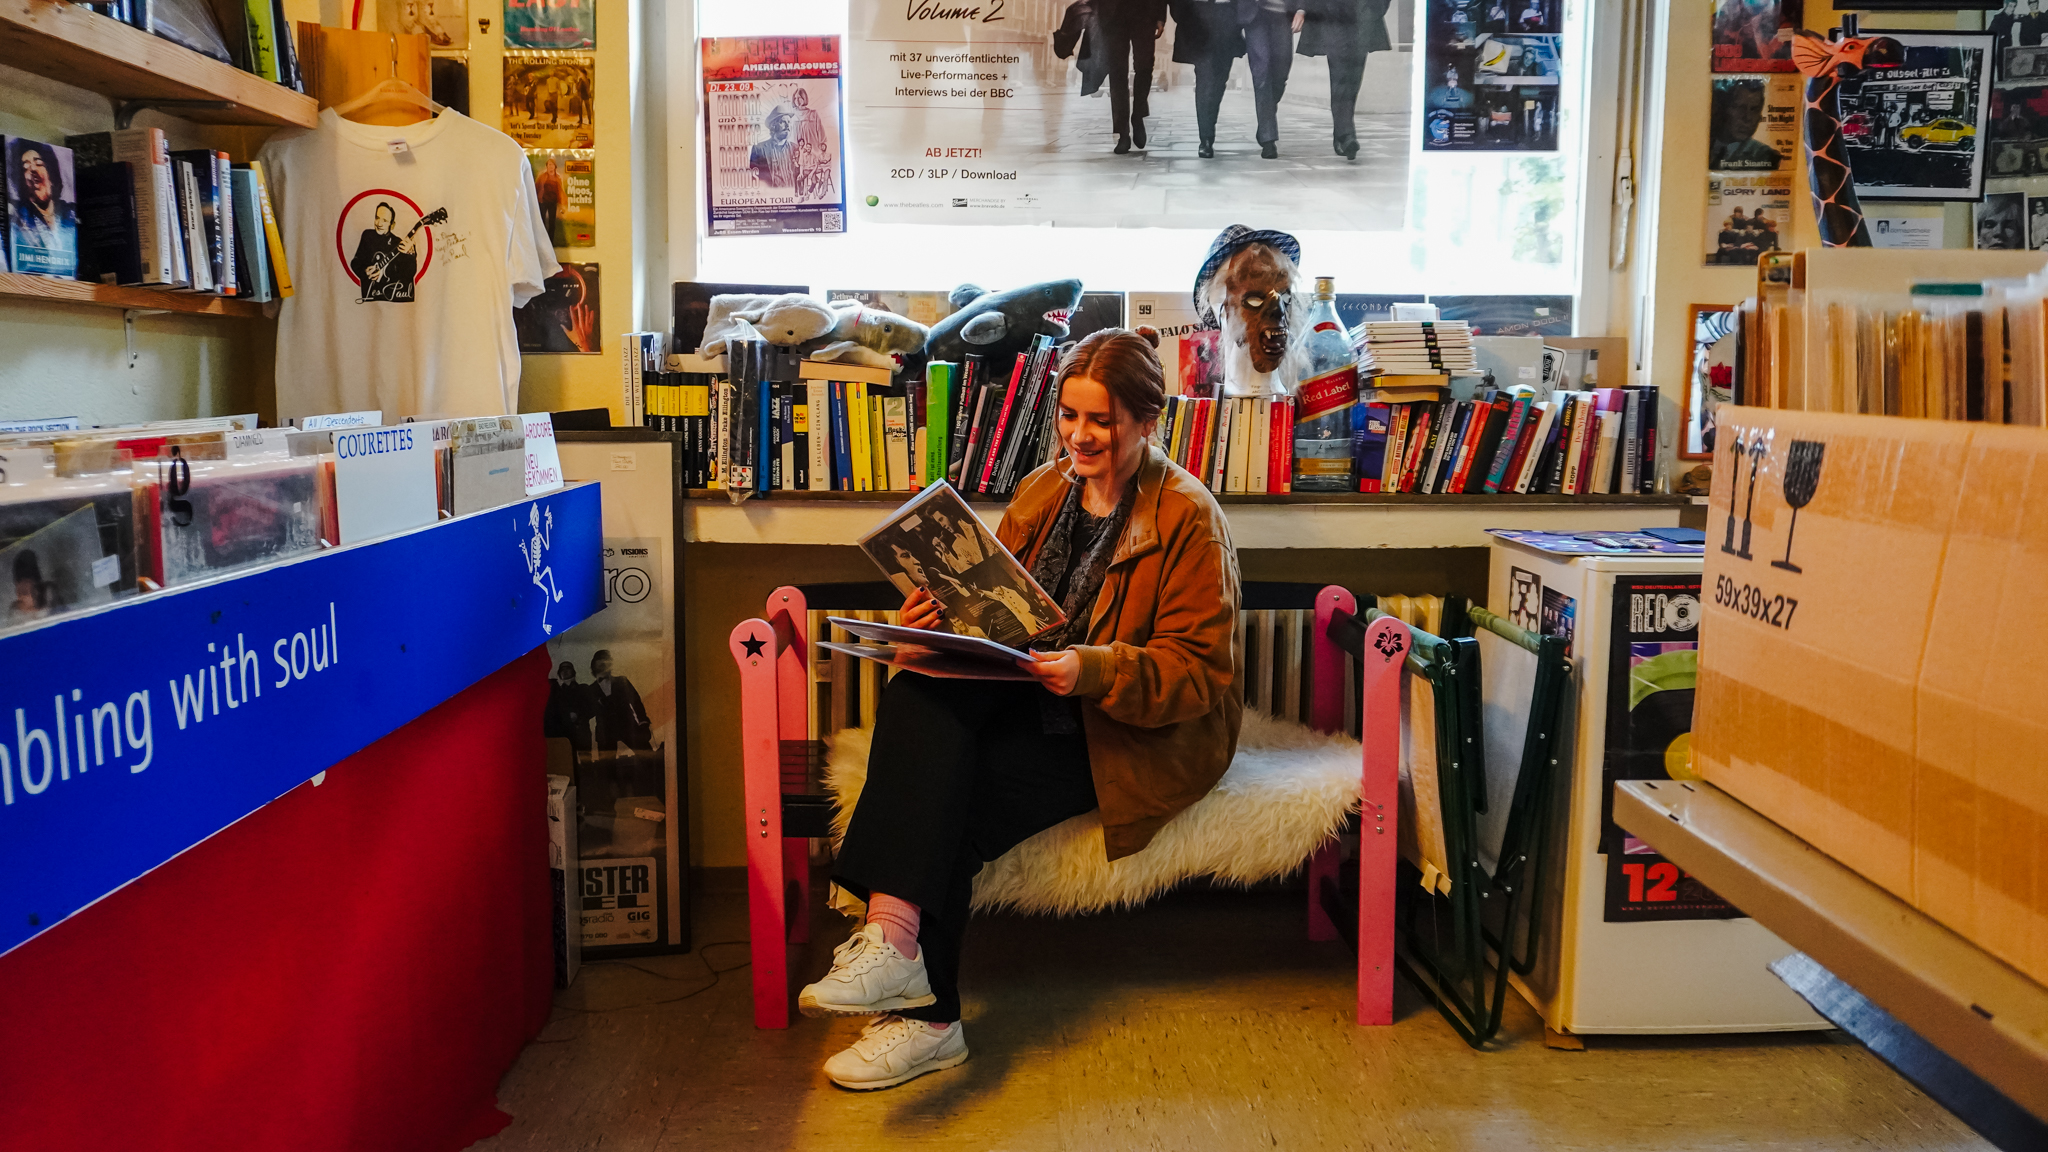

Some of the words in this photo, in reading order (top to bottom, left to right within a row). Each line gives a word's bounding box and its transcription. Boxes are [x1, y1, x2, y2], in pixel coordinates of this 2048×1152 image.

[906, 0, 981, 21] Volume
[982, 0, 1005, 23] 2
[889, 53, 907, 62] mit
[909, 53, 922, 62] 37
[925, 53, 1020, 64] unveröffentlichten
[743, 62, 839, 72] AMERICANASOUNDS
[900, 69, 998, 81] Live-Performances
[1001, 73, 1008, 81] +
[724, 84, 737, 92] 23.
[739, 83, 752, 92] 09.
[895, 86, 948, 97] Interviews
[950, 87, 967, 98] bei
[969, 87, 988, 98] der
[990, 88, 1014, 99] BBC
[1767, 104, 1796, 114] Strangers
[718, 116, 737, 124] and
[1767, 114, 1779, 123] The
[1778, 114, 1795, 124] Night
[718, 124, 737, 147] THE
[719, 146, 750, 168] DARK
[925, 147, 942, 158] AB
[944, 148, 983, 159] JETZT!
[1720, 159, 1743, 167] Frank
[1744, 159, 1772, 167] Sinatra
[720, 167, 760, 190] WOODS
[890, 168, 915, 179] 2CD
[918, 168, 925, 180] /
[927, 169, 949, 179] 3LP
[951, 168, 958, 180] /
[961, 169, 1017, 180] Download
[567, 176, 590, 187] Ohne
[567, 186, 593, 197] Moos,
[1723, 188, 1756, 196] GLORY
[258, 183, 273, 225] HOTEL
[567, 194, 592, 205] nichts
[720, 198, 768, 206] EUROPEAN
[883, 201, 944, 209] www.thebeatles.com
[567, 202, 580, 213] los
[19, 253, 34, 263] JIMI
[36, 254, 71, 266] HENDRIX
[382, 281, 414, 302] Paul
[1138, 304, 1152, 315] 99
[1497, 321, 1530, 335] AMON
[1302, 392, 1324, 405] Red
[1323, 381, 1351, 396] Label
[886, 397, 904, 417] 2
[995, 427, 1003, 439] CITY
[232, 432, 264, 449] DAMNED
[337, 428, 414, 459] COURETTES
[1429, 434, 1438, 450] TAXI
[721, 438, 729, 466] Ellington
[525, 453, 539, 471] NEU
[992, 459, 1001, 477] Dublin
[1556, 452, 1564, 471] Buford
[1569, 465, 1577, 484] BOPP
[620, 548, 649, 556] VISIONS
[1715, 574, 1799, 631] 59x39x27
[169, 633, 261, 731] with
[273, 602, 338, 689] soul
[1621, 862, 1679, 903] 12
[627, 911, 650, 922] GIG
